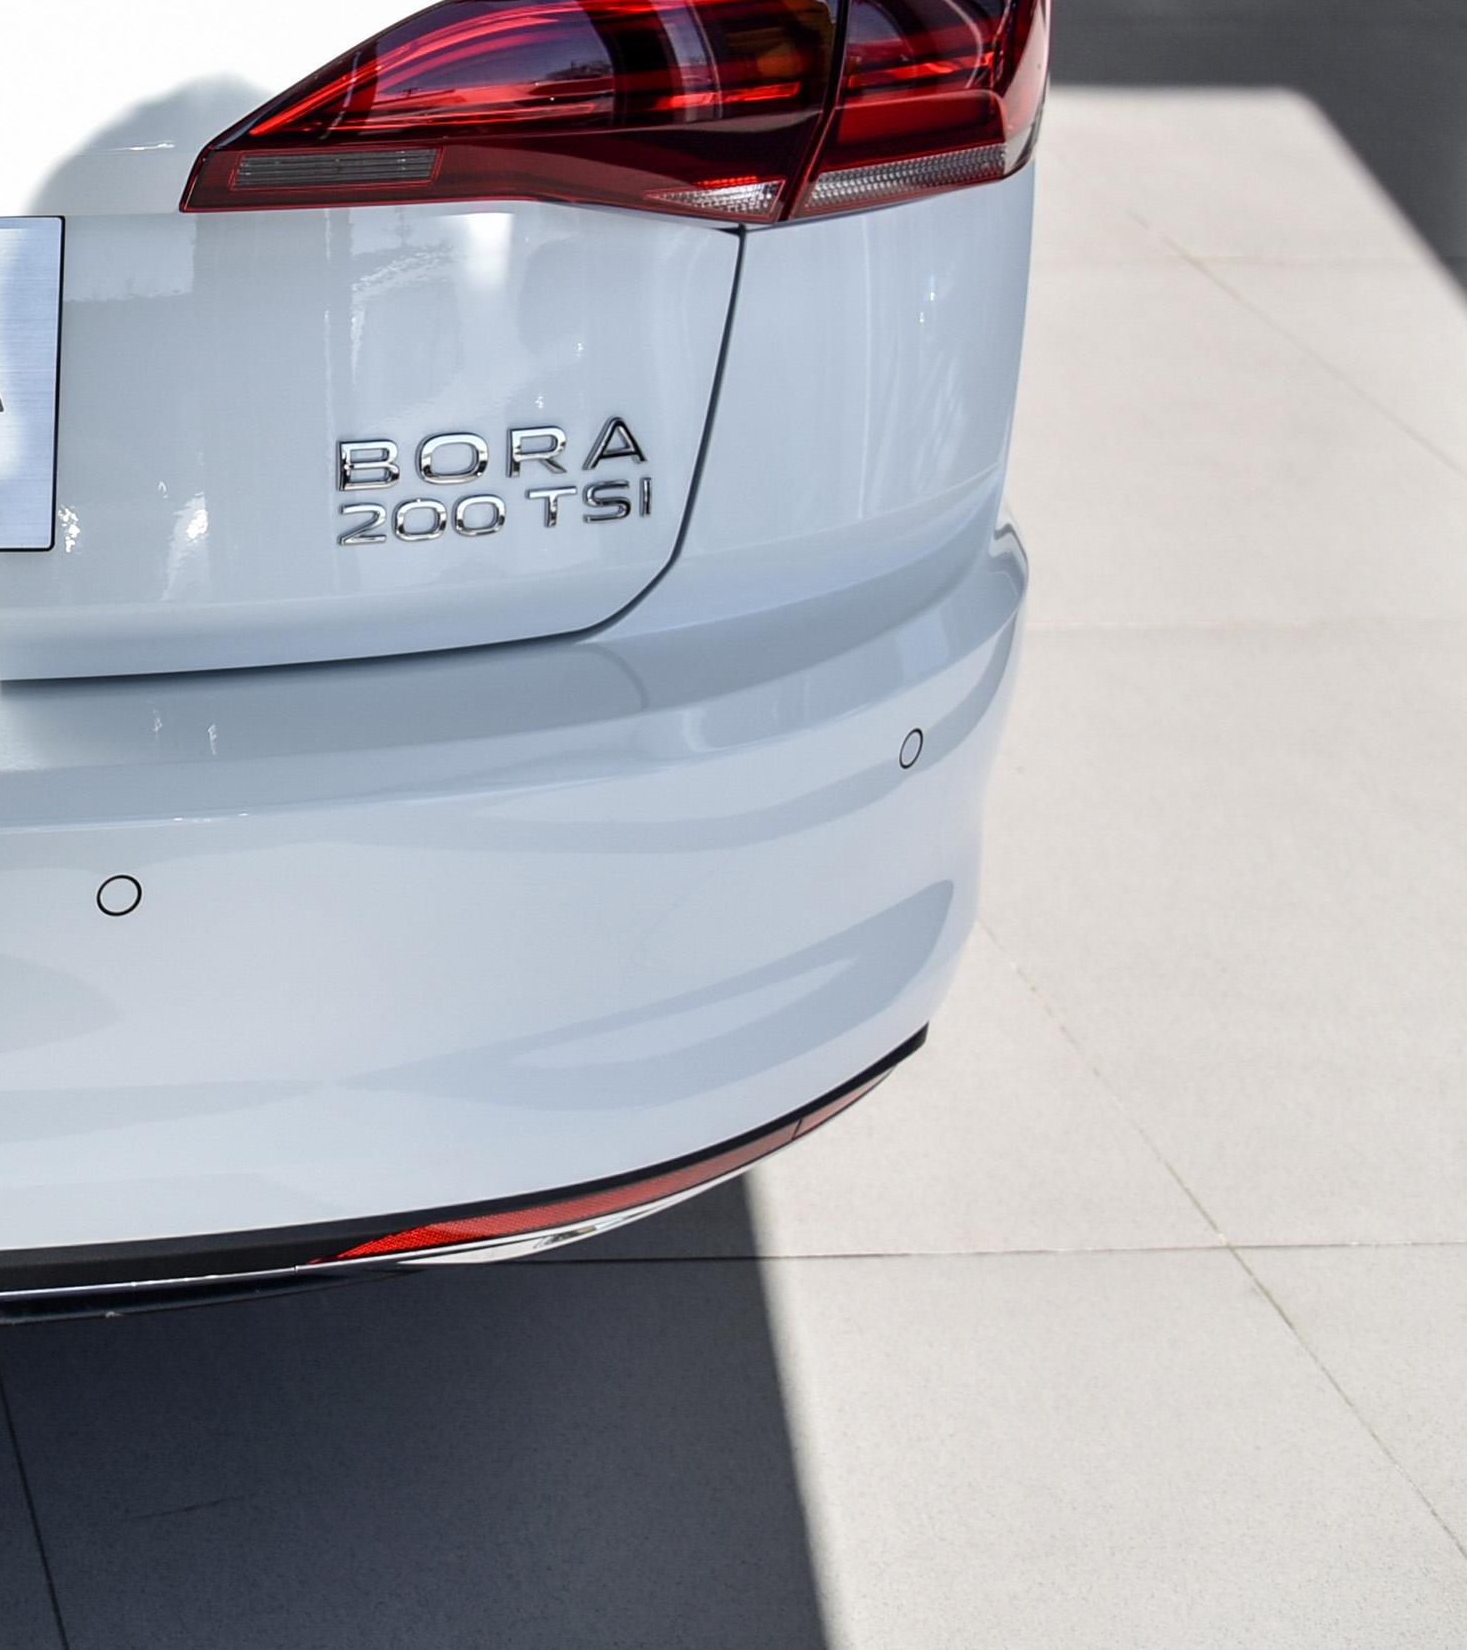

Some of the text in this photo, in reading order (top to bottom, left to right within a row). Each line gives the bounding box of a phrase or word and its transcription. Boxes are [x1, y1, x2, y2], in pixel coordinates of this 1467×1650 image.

[335, 415, 648, 492] BORA
[337, 476, 653, 546] 200 TSI
